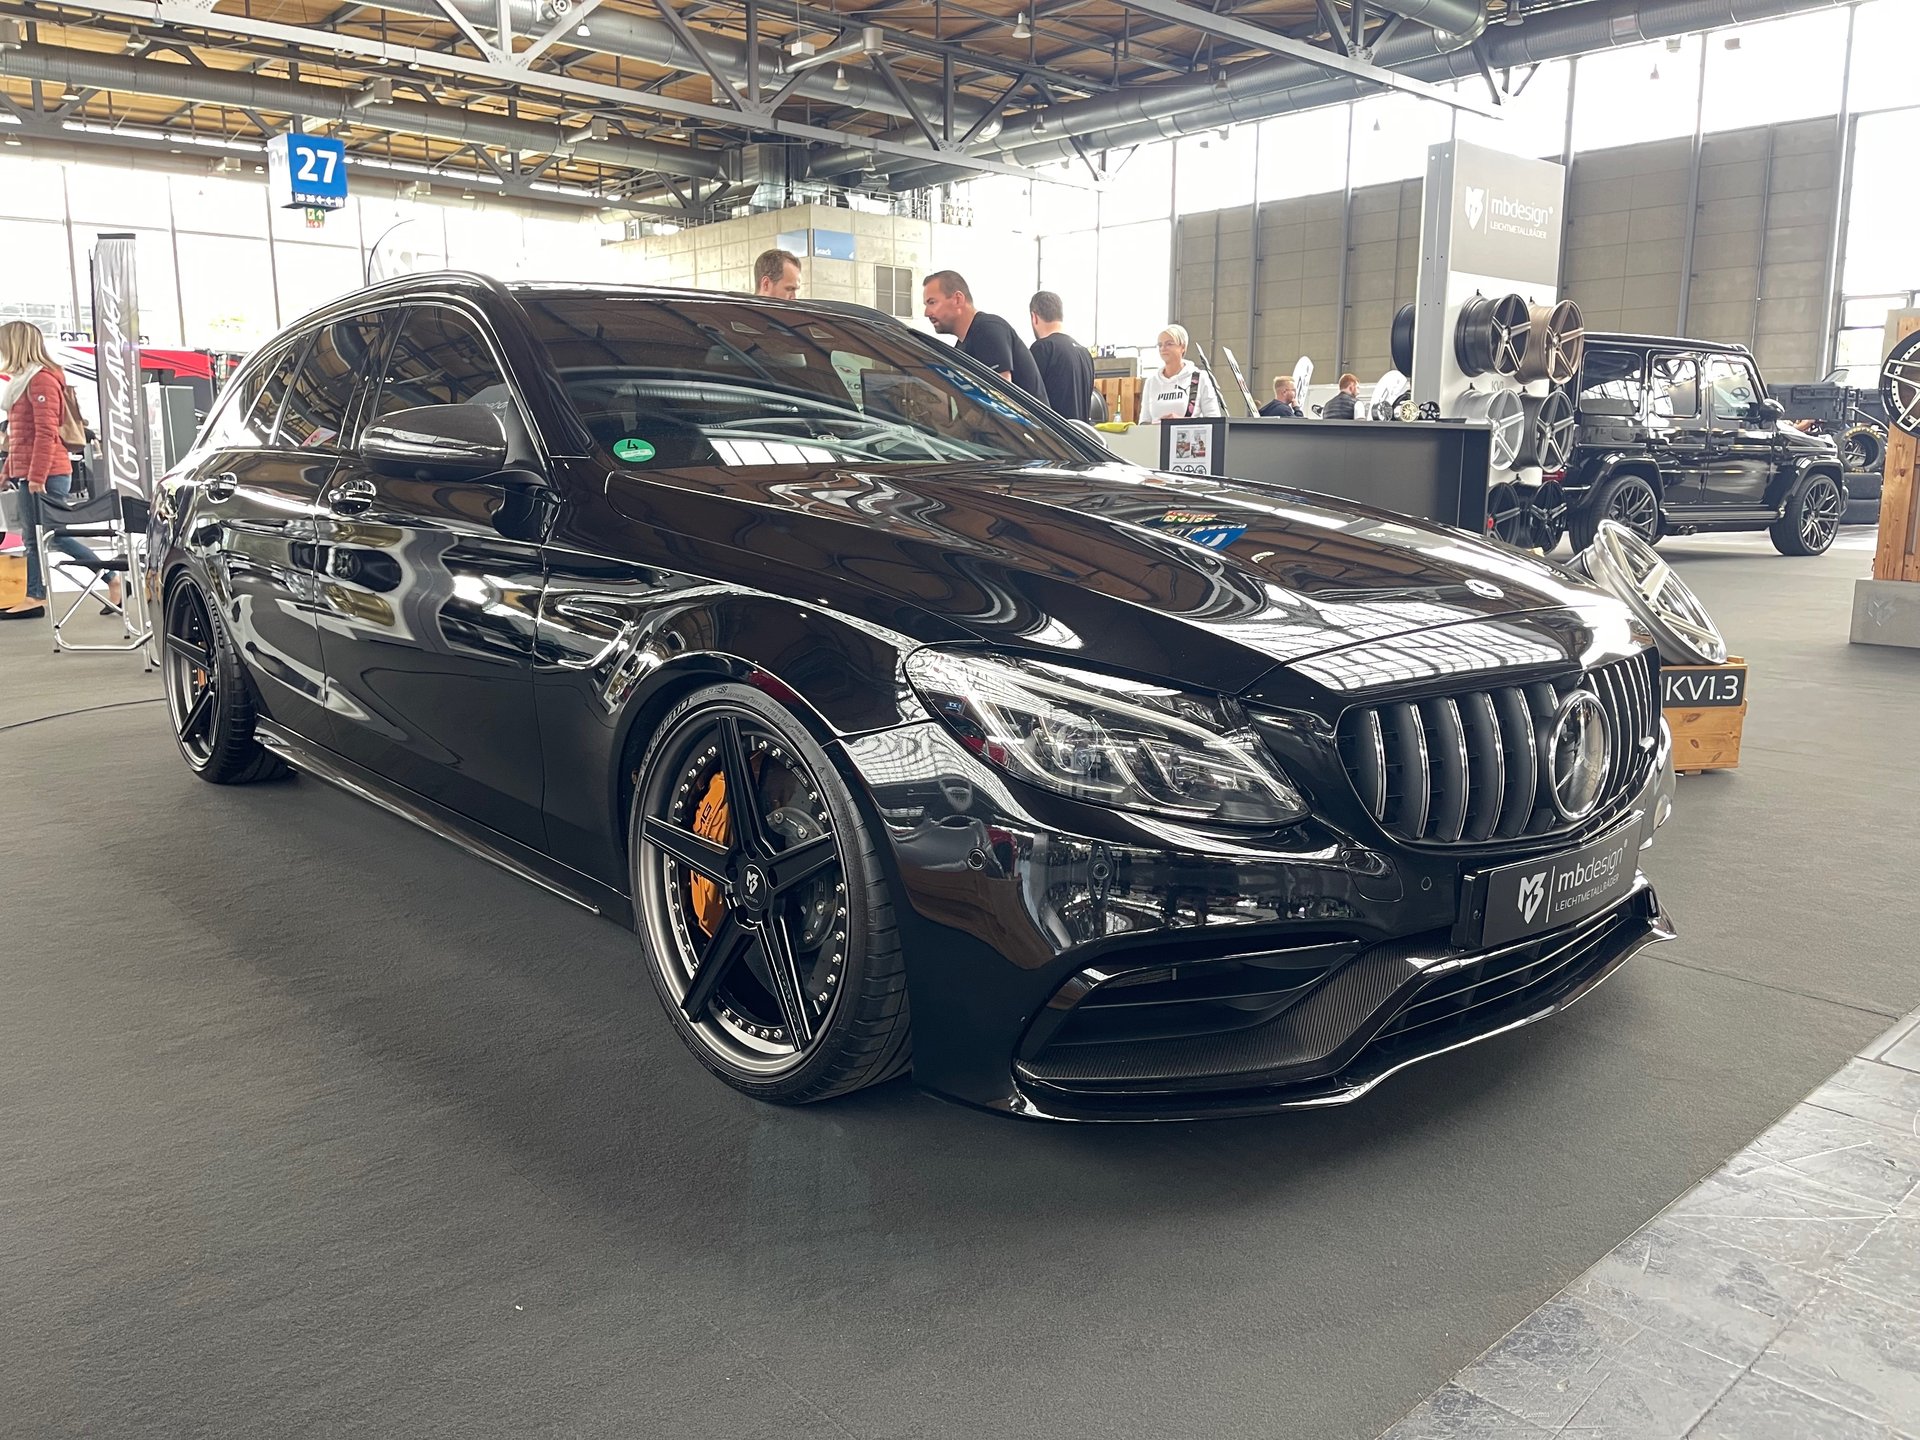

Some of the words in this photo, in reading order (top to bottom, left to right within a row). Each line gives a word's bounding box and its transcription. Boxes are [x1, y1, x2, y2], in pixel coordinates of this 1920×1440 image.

[296, 147, 338, 184] 27
[1490, 195, 1550, 228] mbdesign
[1157, 391, 1183, 401] PUMA
[627, 440, 638, 450] 4
[208, 595, 225, 650] MICHELIN
[1665, 675, 1739, 702] KV1.3
[1558, 847, 1623, 892] mbdesign
[1555, 873, 1620, 912] LEICHTMETALLRÄDER
